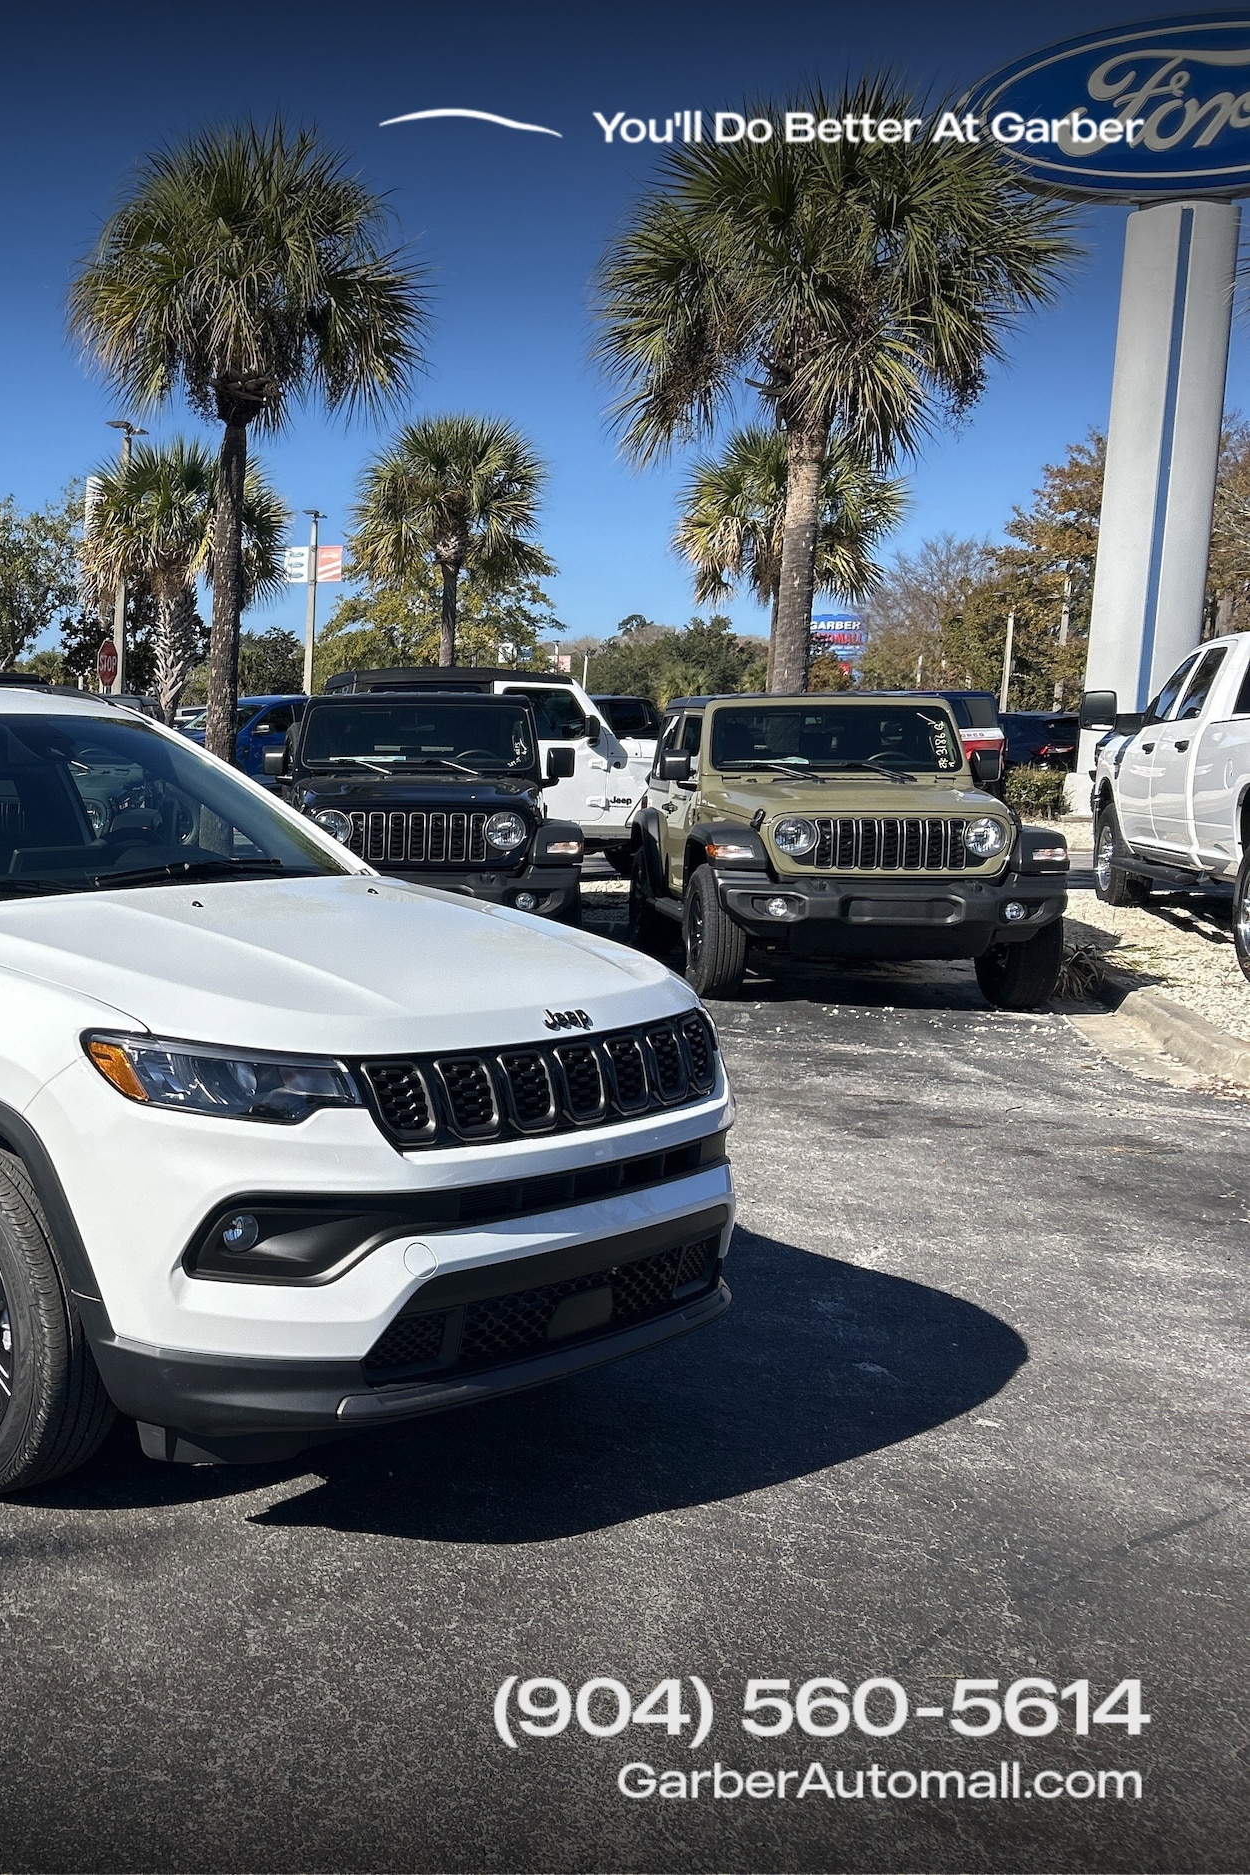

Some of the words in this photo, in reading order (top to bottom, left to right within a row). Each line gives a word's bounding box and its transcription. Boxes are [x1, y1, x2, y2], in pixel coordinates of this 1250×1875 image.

[1057, 49, 1250, 157] For
[810, 620, 861, 630] GARBER
[99, 655, 117, 672] STOP
[610, 796, 632, 806] Jeep
[542, 1009, 593, 1032] Jeep
